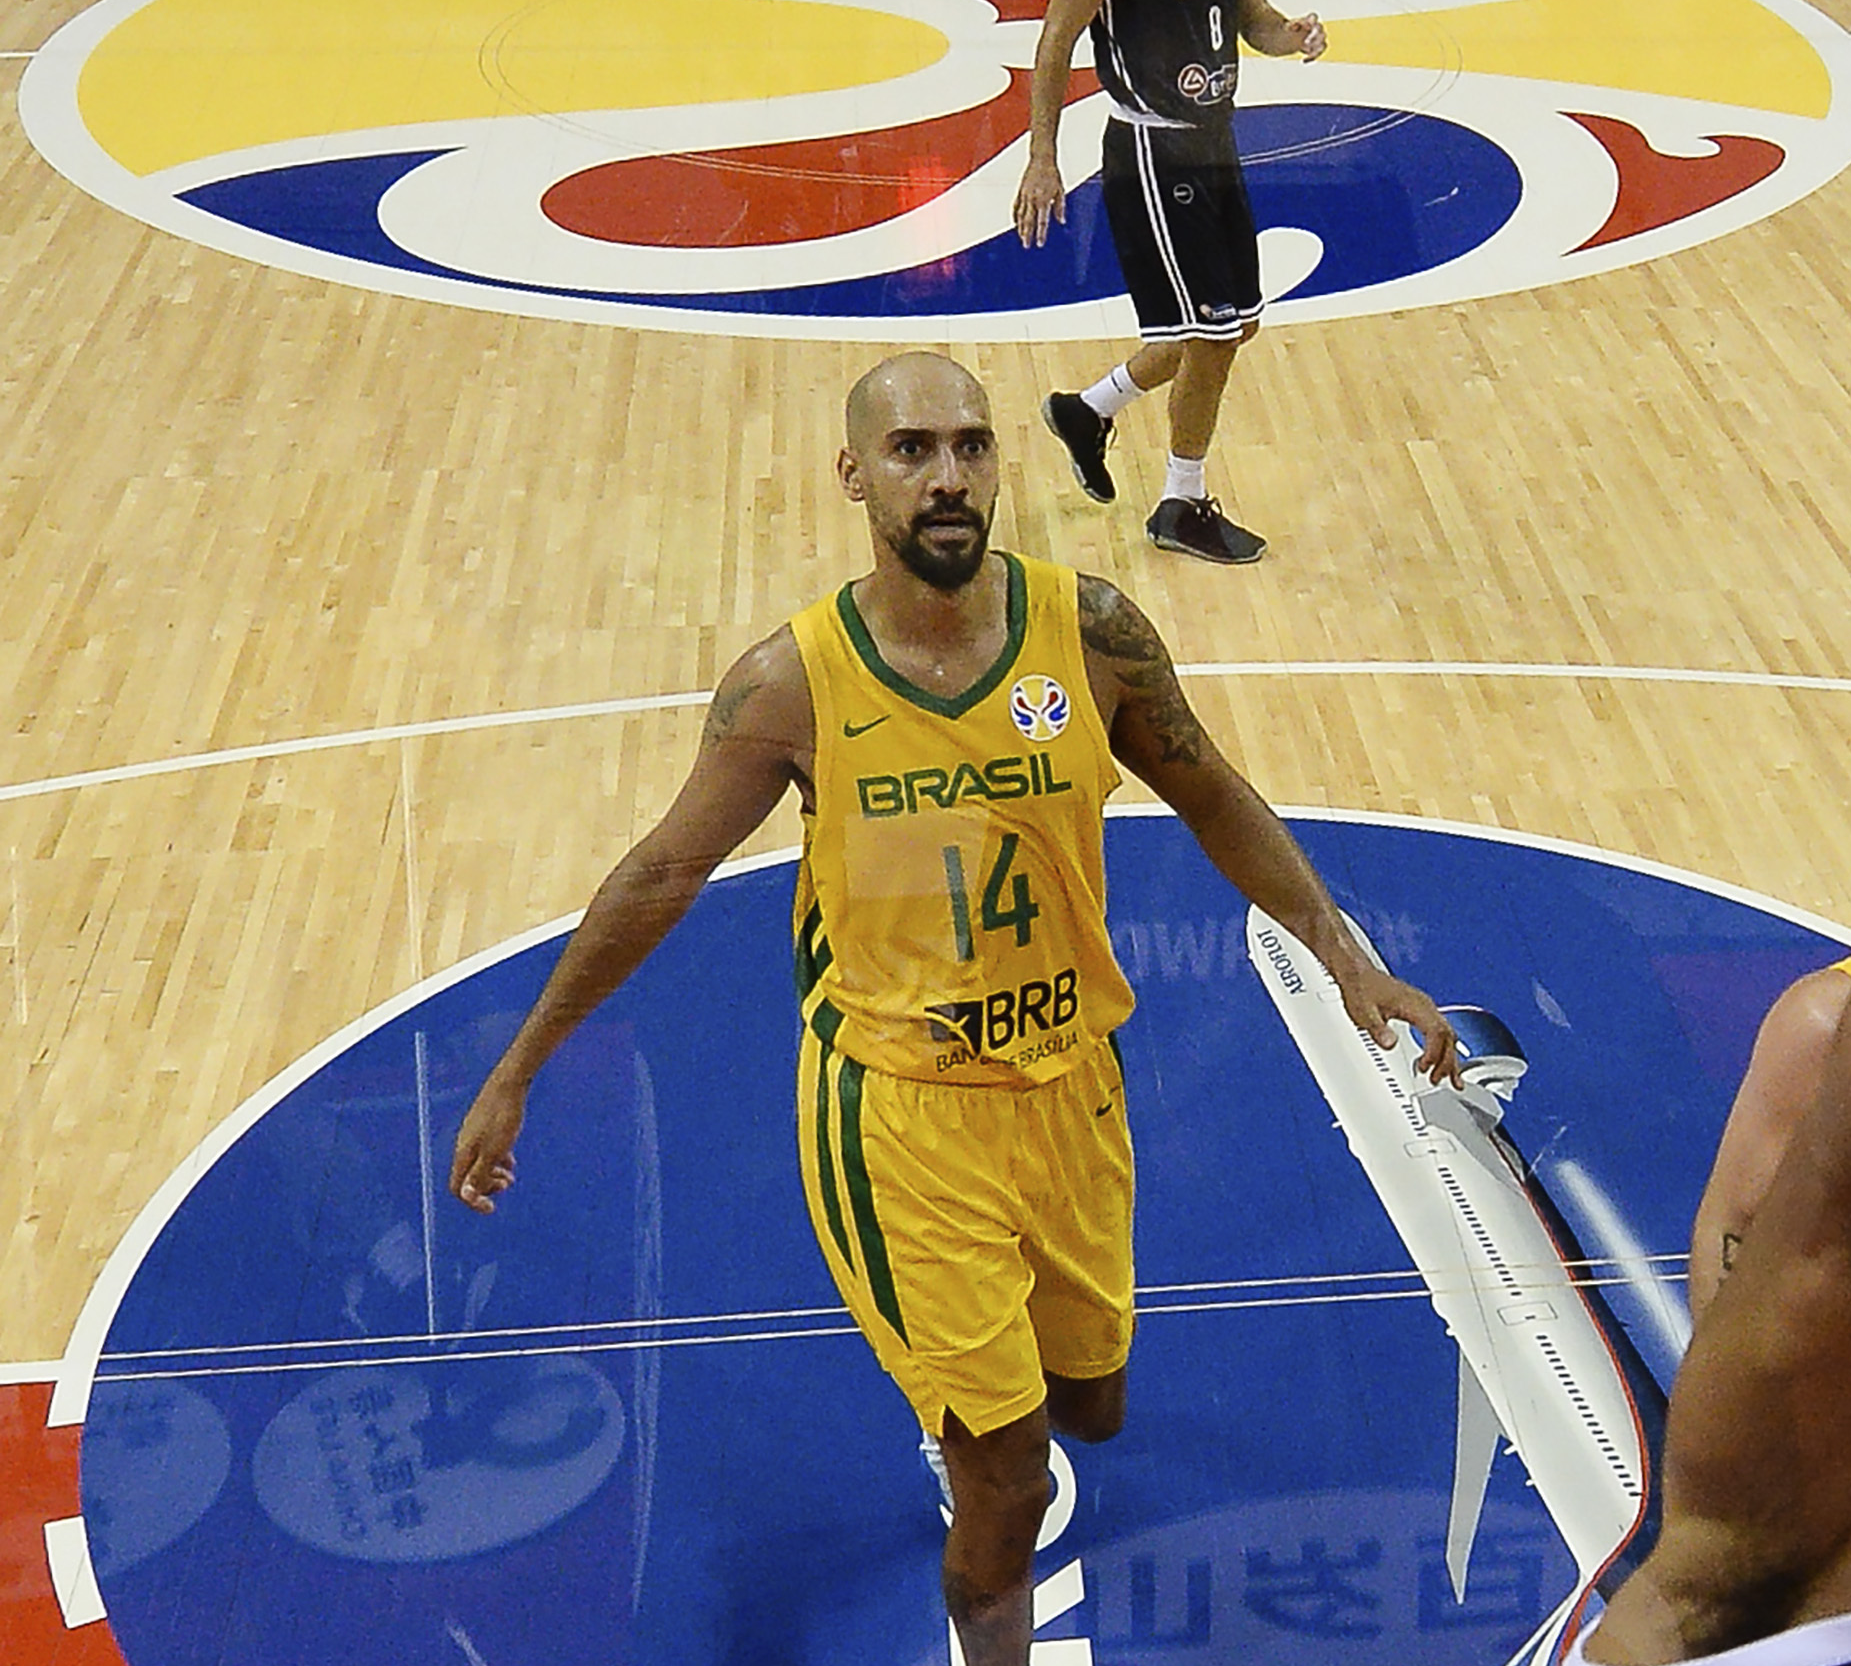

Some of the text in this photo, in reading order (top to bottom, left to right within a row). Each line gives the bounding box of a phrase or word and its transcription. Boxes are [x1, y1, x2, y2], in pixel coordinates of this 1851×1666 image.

[1208, 6, 1224, 52] 8
[857, 751, 1072, 818] BRASIL
[941, 833, 1040, 963] 14
[1256, 928, 1307, 995] AEROFLOT
[986, 967, 1078, 1051] BRB
